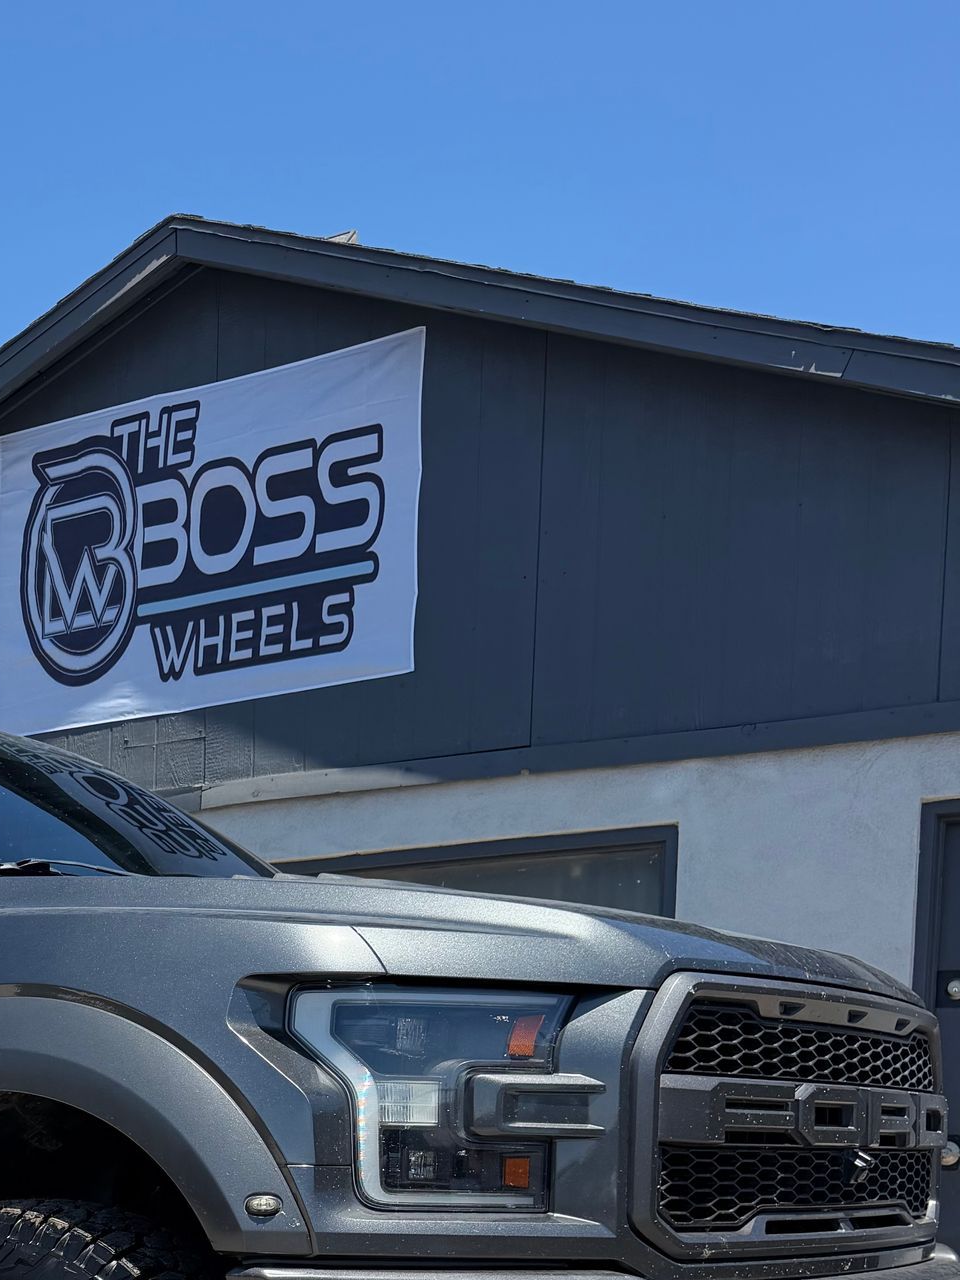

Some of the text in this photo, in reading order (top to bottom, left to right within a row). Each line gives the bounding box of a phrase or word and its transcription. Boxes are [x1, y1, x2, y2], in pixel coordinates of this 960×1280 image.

[112, 401, 200, 473] THE
[136, 426, 383, 590] BOSS
[152, 587, 354, 680] WHEELS
[710, 1082, 948, 1149] FORD
